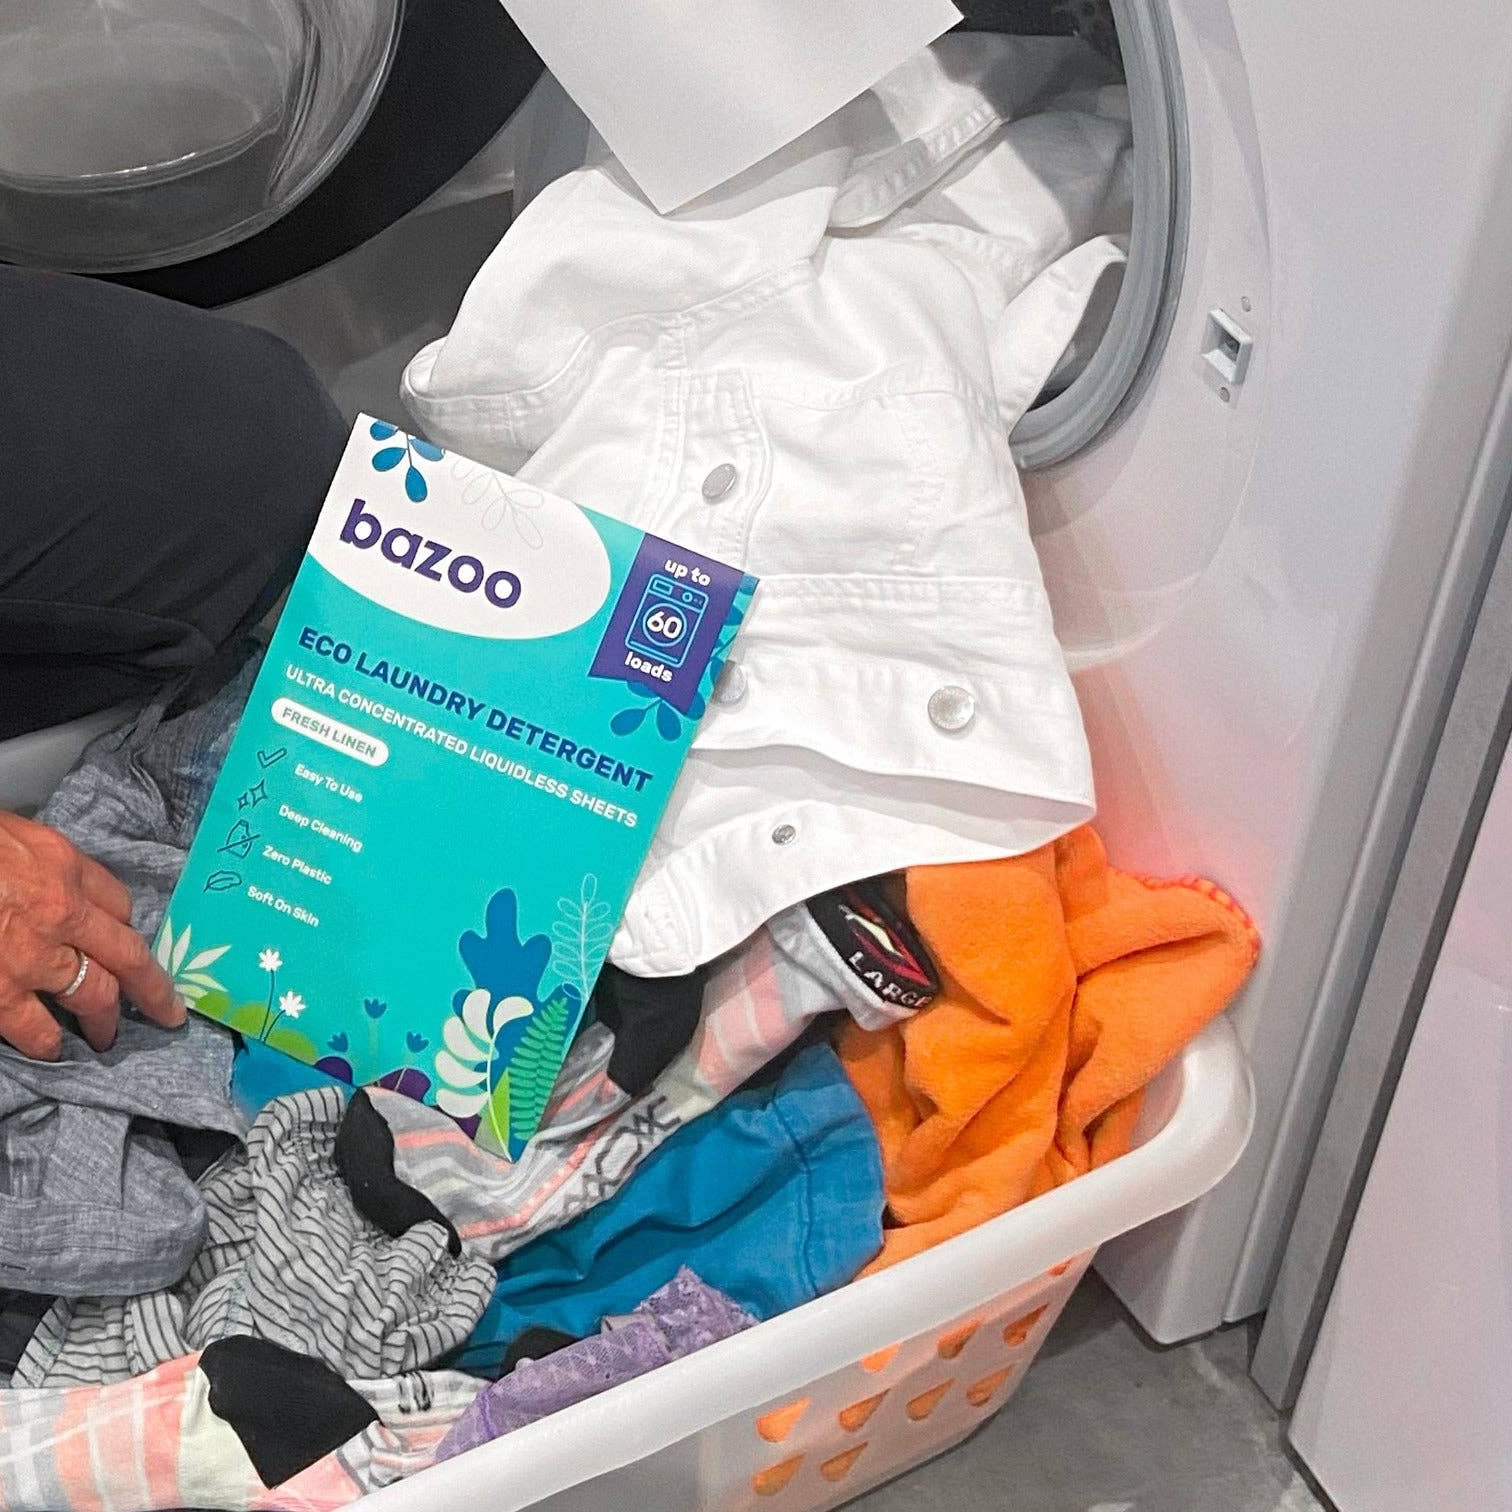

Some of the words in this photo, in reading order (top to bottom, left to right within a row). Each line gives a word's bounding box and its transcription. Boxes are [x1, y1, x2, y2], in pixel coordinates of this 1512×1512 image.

[339, 498, 521, 608] bazoo
[664, 560, 688, 579] up
[691, 567, 711, 586] to
[646, 611, 683, 639] 60
[624, 652, 673, 682] loads
[298, 626, 352, 665] ECO
[355, 652, 486, 721] LAUNDRY
[486, 708, 654, 792] DETERGENT
[282, 707, 331, 738] FRESH
[332, 730, 377, 758] LINEN
[285, 664, 336, 700] ULTRA
[337, 687, 468, 755] CONCENTRATED
[469, 745, 569, 799] LIQUIDLESS
[569, 789, 638, 828] SHEETS
[295, 763, 324, 786] Easy
[325, 776, 339, 792] To
[339, 783, 363, 803] Use
[279, 804, 310, 828] Deep
[310, 819, 363, 853] Cleaning
[263, 845, 291, 866] Zero
[291, 858, 332, 885] Plastic
[248, 885, 274, 907] Soft
[274, 898, 292, 914] On
[292, 906, 319, 928] Skin
